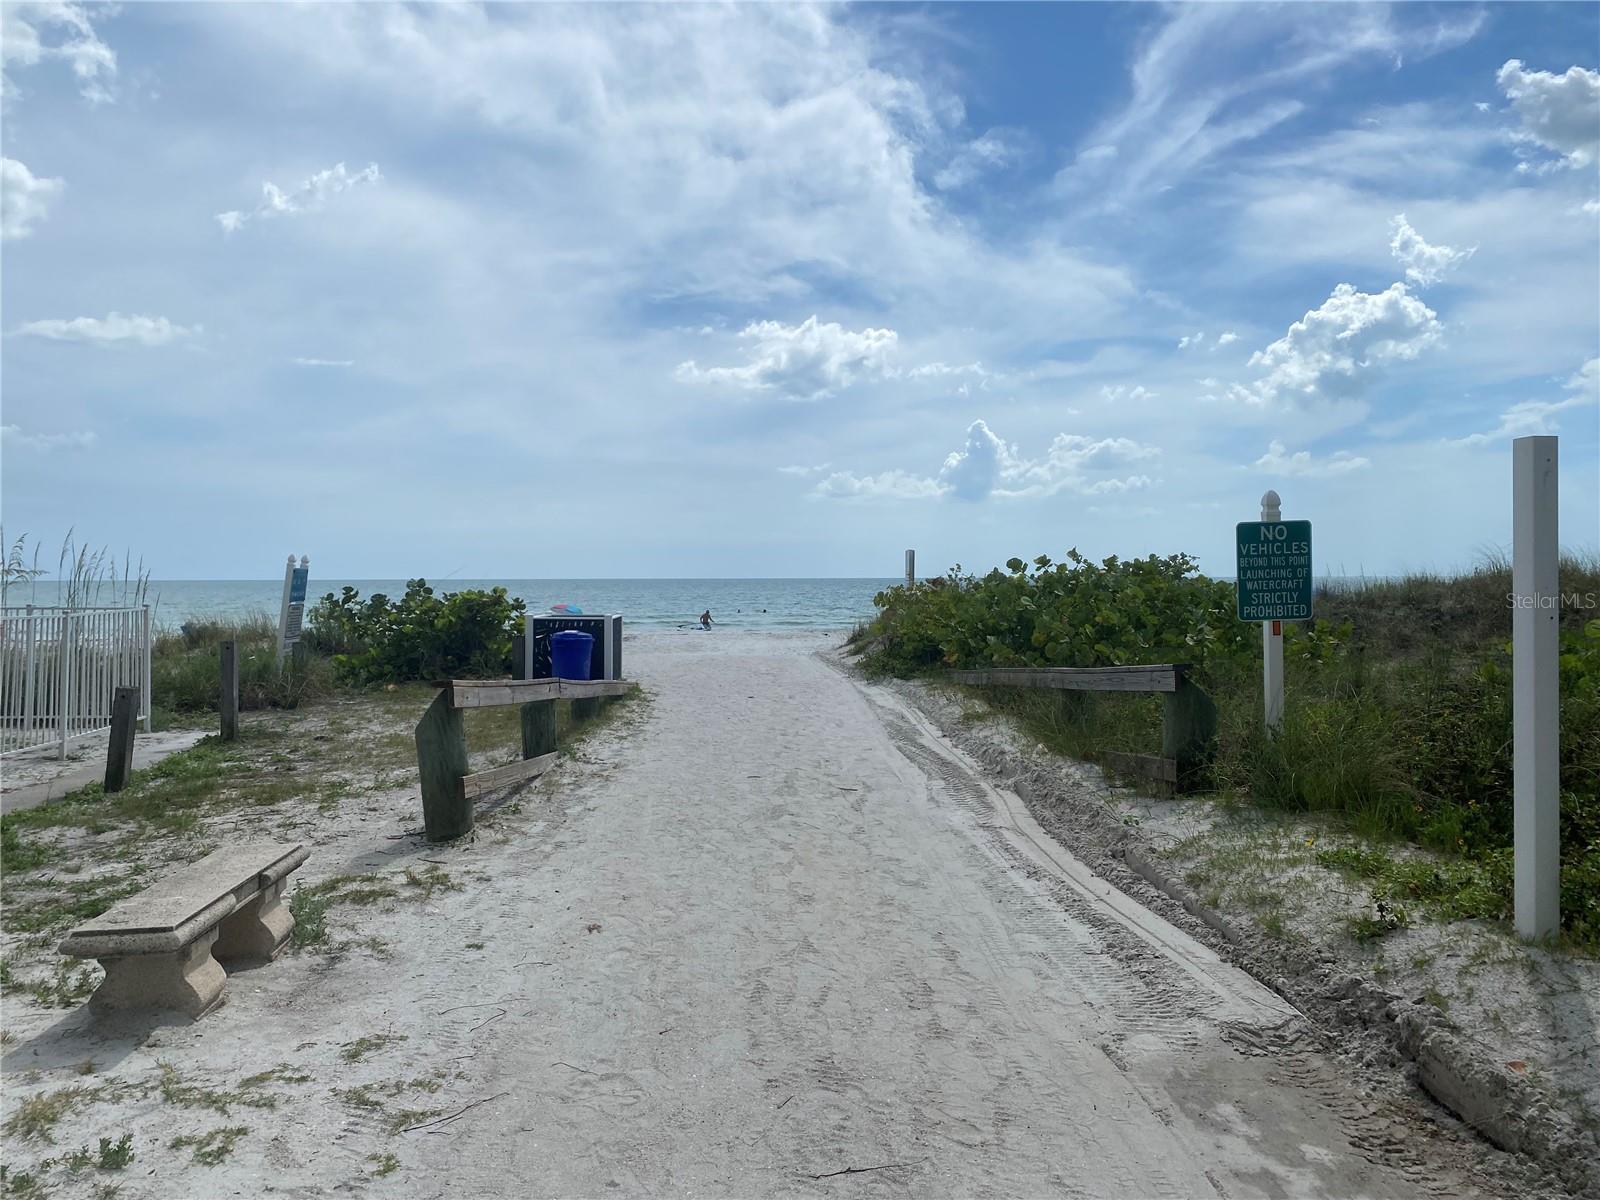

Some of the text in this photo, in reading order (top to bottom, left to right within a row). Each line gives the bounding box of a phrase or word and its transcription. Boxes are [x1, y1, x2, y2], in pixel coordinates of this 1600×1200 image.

[1261, 525, 1287, 540] NO
[1240, 542, 1309, 555] VEHICLES
[1240, 556, 1309, 567] BEYOND THIS POINT
[1240, 568, 1308, 579] LAUNCHING OF
[1246, 580, 1304, 590] WATERCRAFT
[1251, 592, 1299, 604] STRICTLY
[1243, 604, 1307, 617] PROHIBITED
